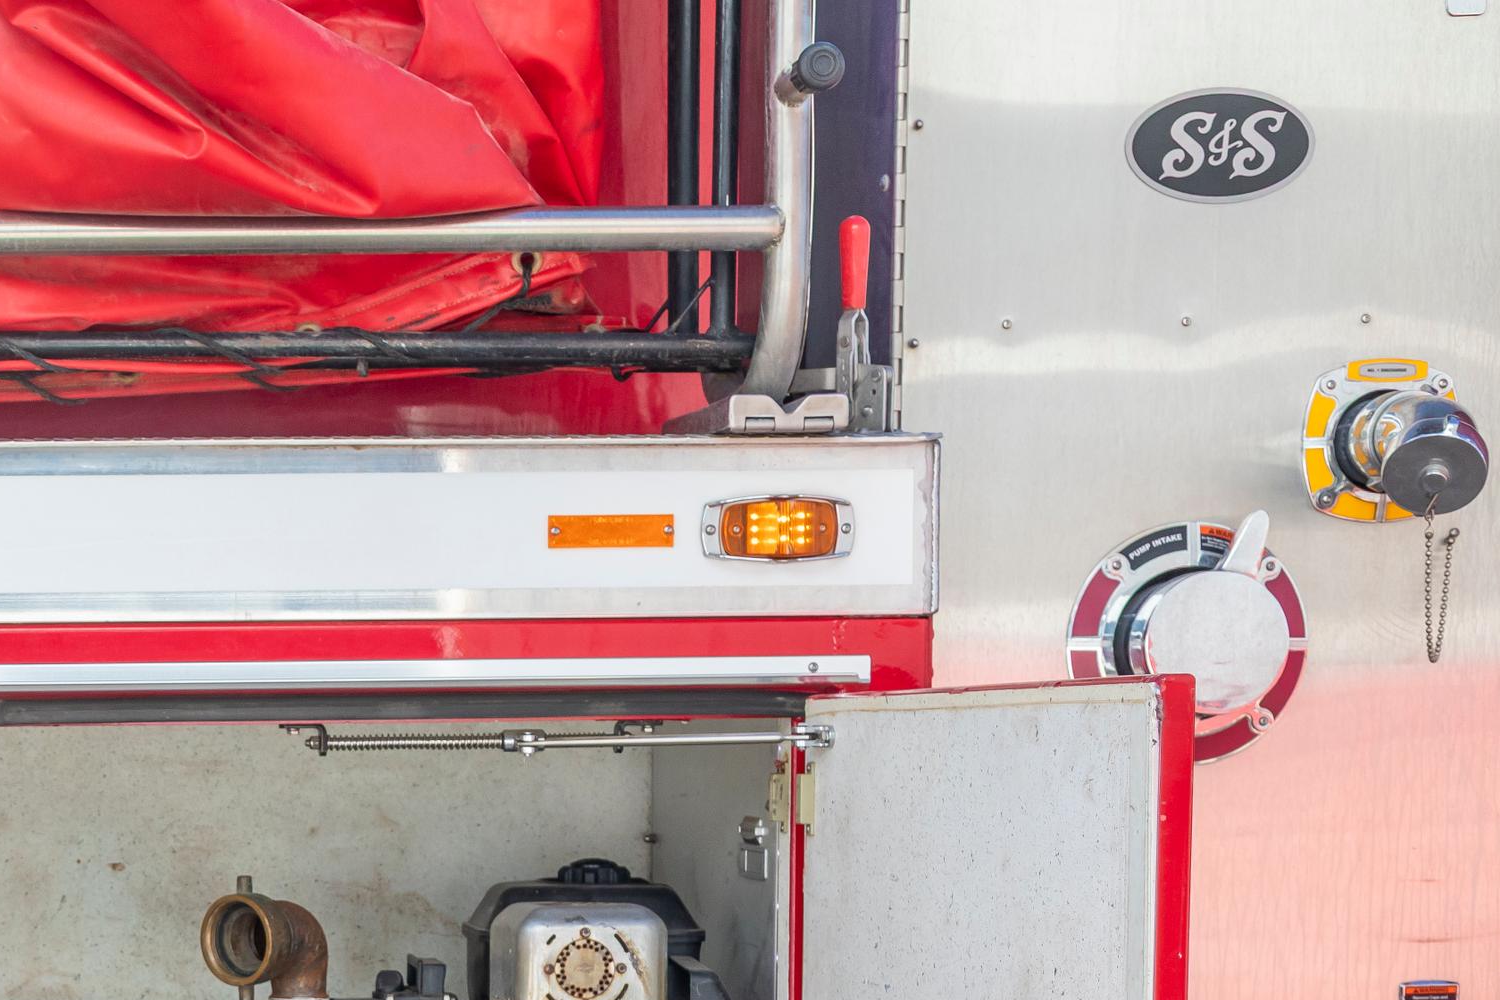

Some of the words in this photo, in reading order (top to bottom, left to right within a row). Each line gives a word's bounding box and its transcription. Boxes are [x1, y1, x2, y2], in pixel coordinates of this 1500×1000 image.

[1159, 110, 1287, 180] S&S
[1128, 543, 1151, 560] PUMP
[1151, 533, 1183, 548] INTAKE
